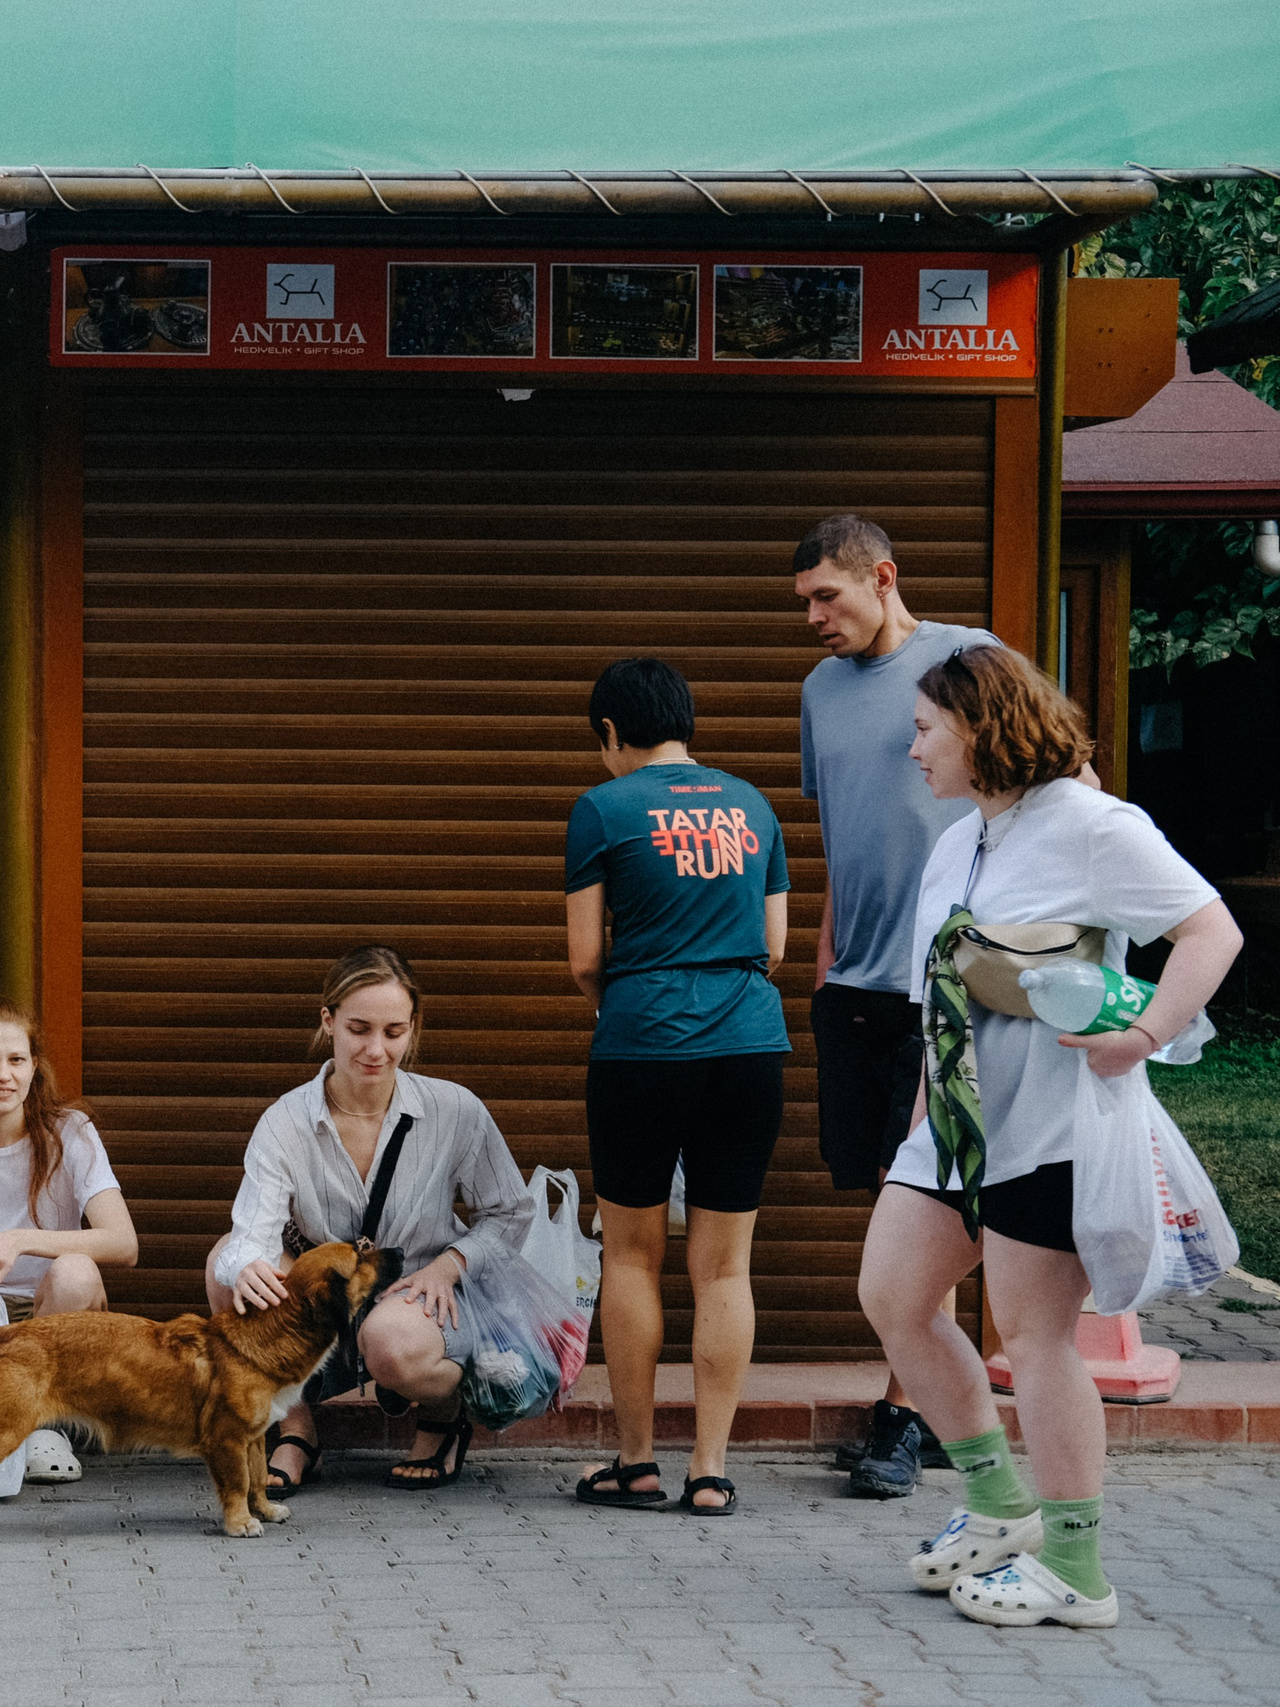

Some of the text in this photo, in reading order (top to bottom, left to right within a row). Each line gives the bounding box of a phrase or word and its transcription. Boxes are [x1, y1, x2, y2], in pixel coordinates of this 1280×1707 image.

[229, 322, 367, 344] ANTALIA
[881, 329, 1020, 351] ANTALIA
[304, 347, 329, 355] GIFT
[332, 347, 365, 355] SHOP
[956, 353, 982, 361] GIFT
[984, 354, 1018, 362] SHOP
[647, 807, 748, 831] TATAR
[675, 846, 744, 880] RUN
